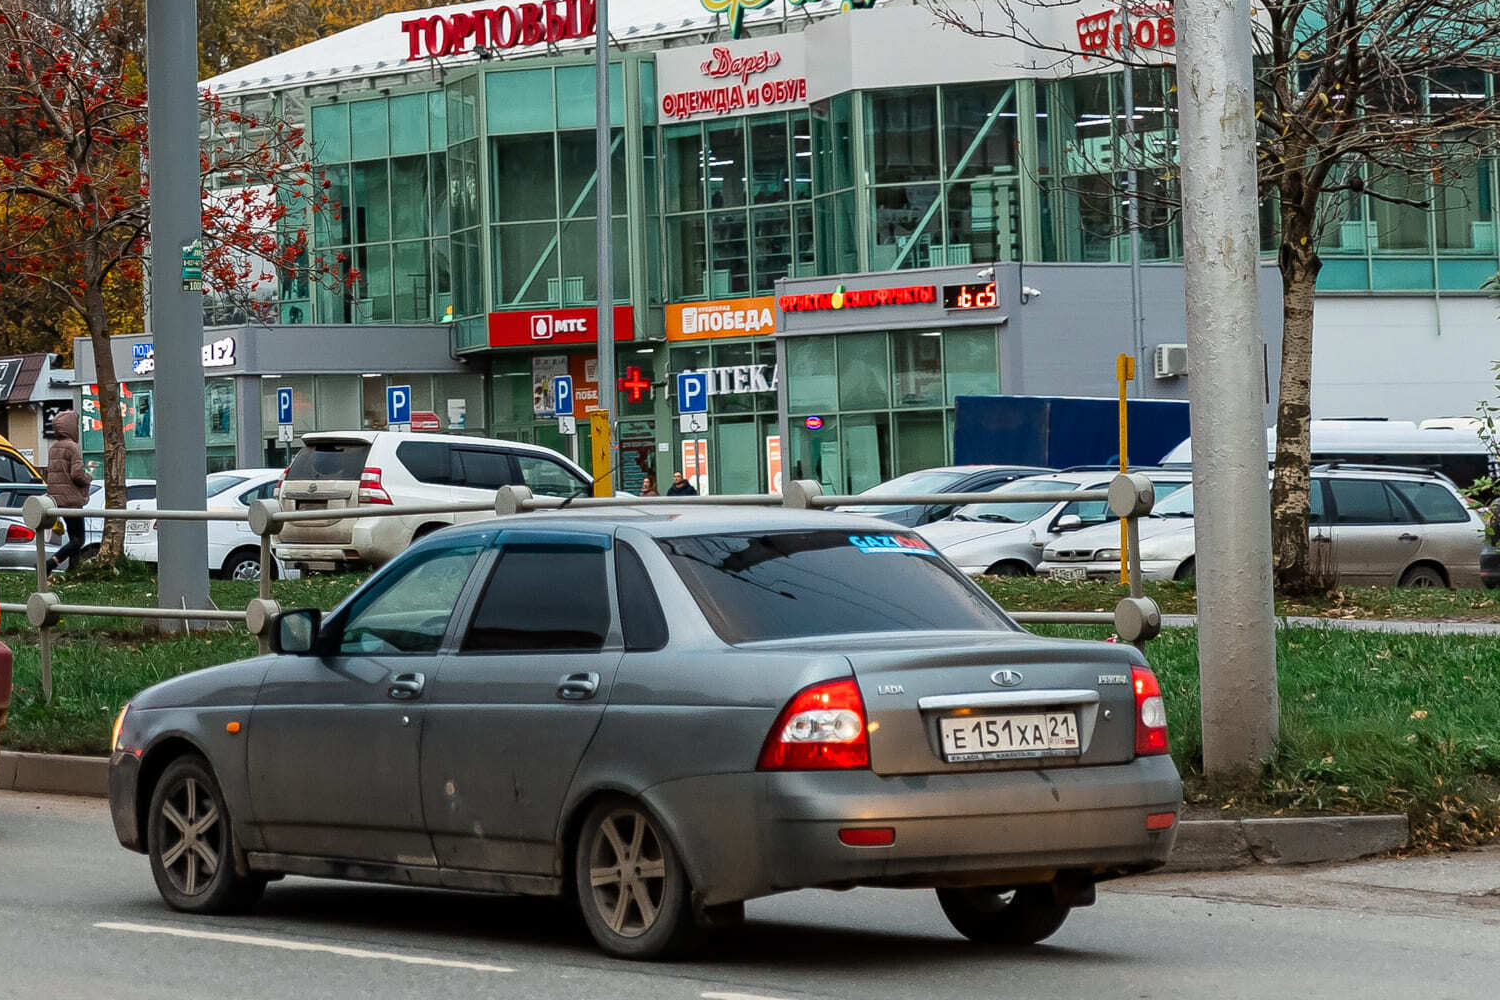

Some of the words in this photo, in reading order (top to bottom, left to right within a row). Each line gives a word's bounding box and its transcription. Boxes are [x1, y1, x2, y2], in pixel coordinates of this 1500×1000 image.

[662, 85, 745, 119] ОДЕЖДА
[746, 87, 760, 107] и
[554, 317, 588, 333] МТС
[698, 308, 773, 332] ПОБЕДА
[202, 337, 235, 367] ELE2
[685, 364, 779, 396] ПТЕК
[878, 685, 904, 695] LADA
[1050, 716, 1070, 737] 21
